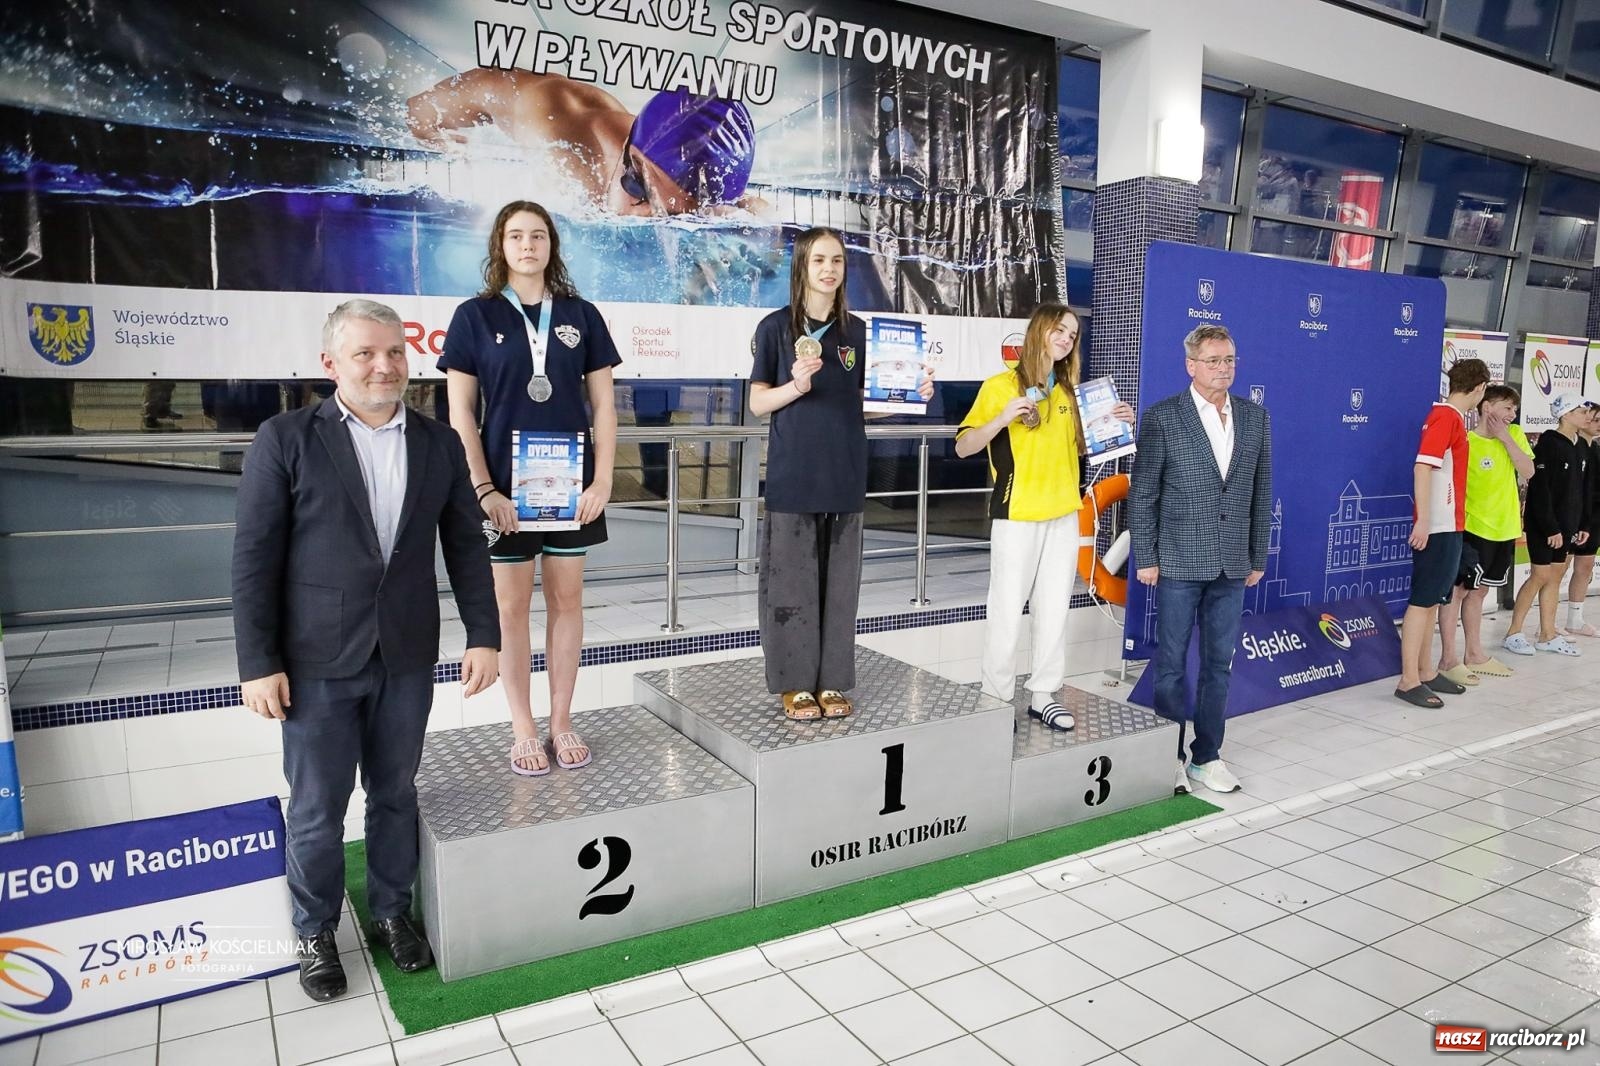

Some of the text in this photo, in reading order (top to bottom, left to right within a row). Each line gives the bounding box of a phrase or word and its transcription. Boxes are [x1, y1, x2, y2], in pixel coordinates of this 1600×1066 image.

[727, 0, 992, 84] SPORTOWYCH
[475, 21, 777, 105] W PŁYWANIU
[112, 310, 229, 327] Województwo
[1188, 308, 1222, 321] Racibórz
[632, 325, 672, 336] Ośrodek
[1299, 320, 1328, 331] Racibórz
[1393, 327, 1418, 337] Racibórz
[115, 328, 175, 348] Śląskie
[632, 336, 664, 348] Sportu
[638, 347, 680, 360] Rekreacji
[1554, 364, 1580, 379] ZSOMS
[1342, 414, 1369, 423] Racibórz
[527, 444, 569, 457] DYPLOM
[1343, 616, 1376, 633] ZSOMS
[1242, 629, 1307, 662] Śląskie.
[1278, 659, 1346, 688] smsraciborz.pl
[879, 743, 906, 816] 1
[1084, 755, 1113, 806] 3
[810, 815, 968, 869] OSIR RACIBÓRZ
[89, 860, 115, 883] w
[125, 829, 277, 877] Raciborzu
[577, 835, 635, 920] 2
[79, 920, 208, 973] ZSOMS
[80, 950, 209, 990] RACIBÓRZ
